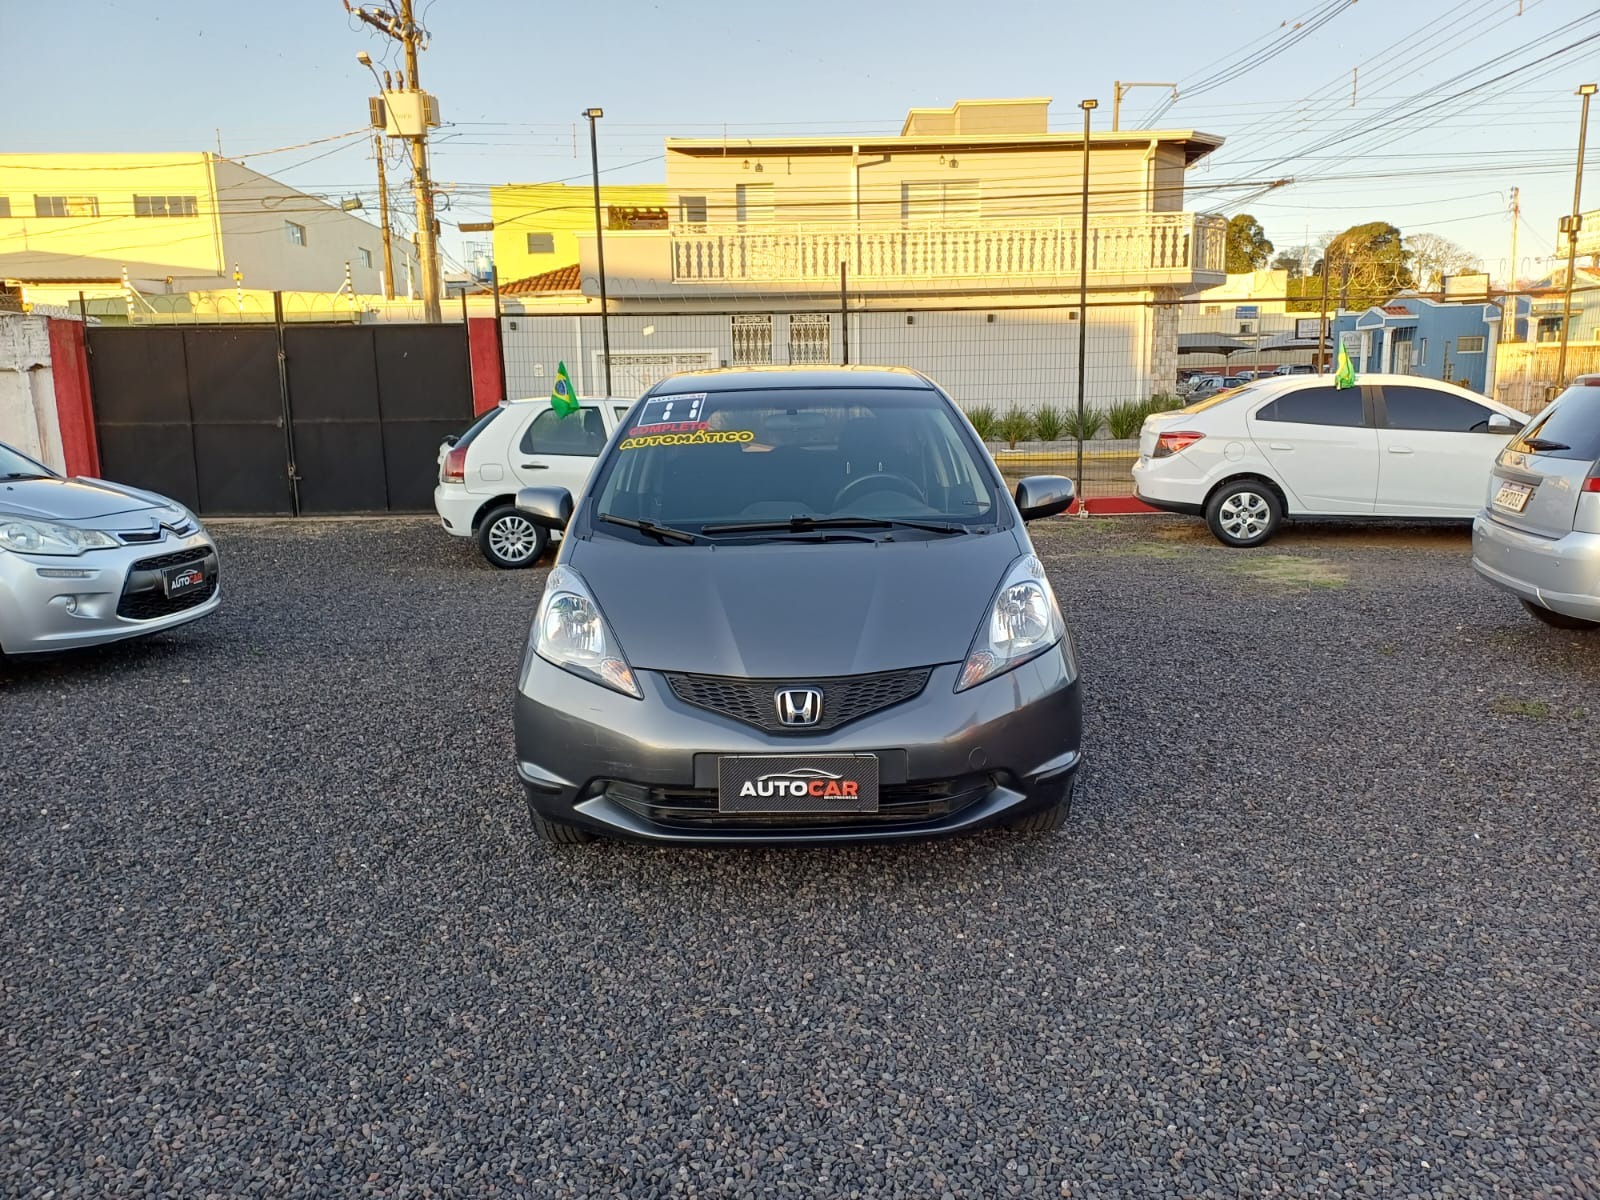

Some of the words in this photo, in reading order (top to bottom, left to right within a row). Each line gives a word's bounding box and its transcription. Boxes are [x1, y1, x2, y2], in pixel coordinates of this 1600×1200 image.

[629, 421, 710, 436] COMPLETO
[619, 430, 755, 450] AUTOMÁTICO
[171, 572, 203, 590] AUTOCAR
[739, 780, 859, 797] AUTOCAR
